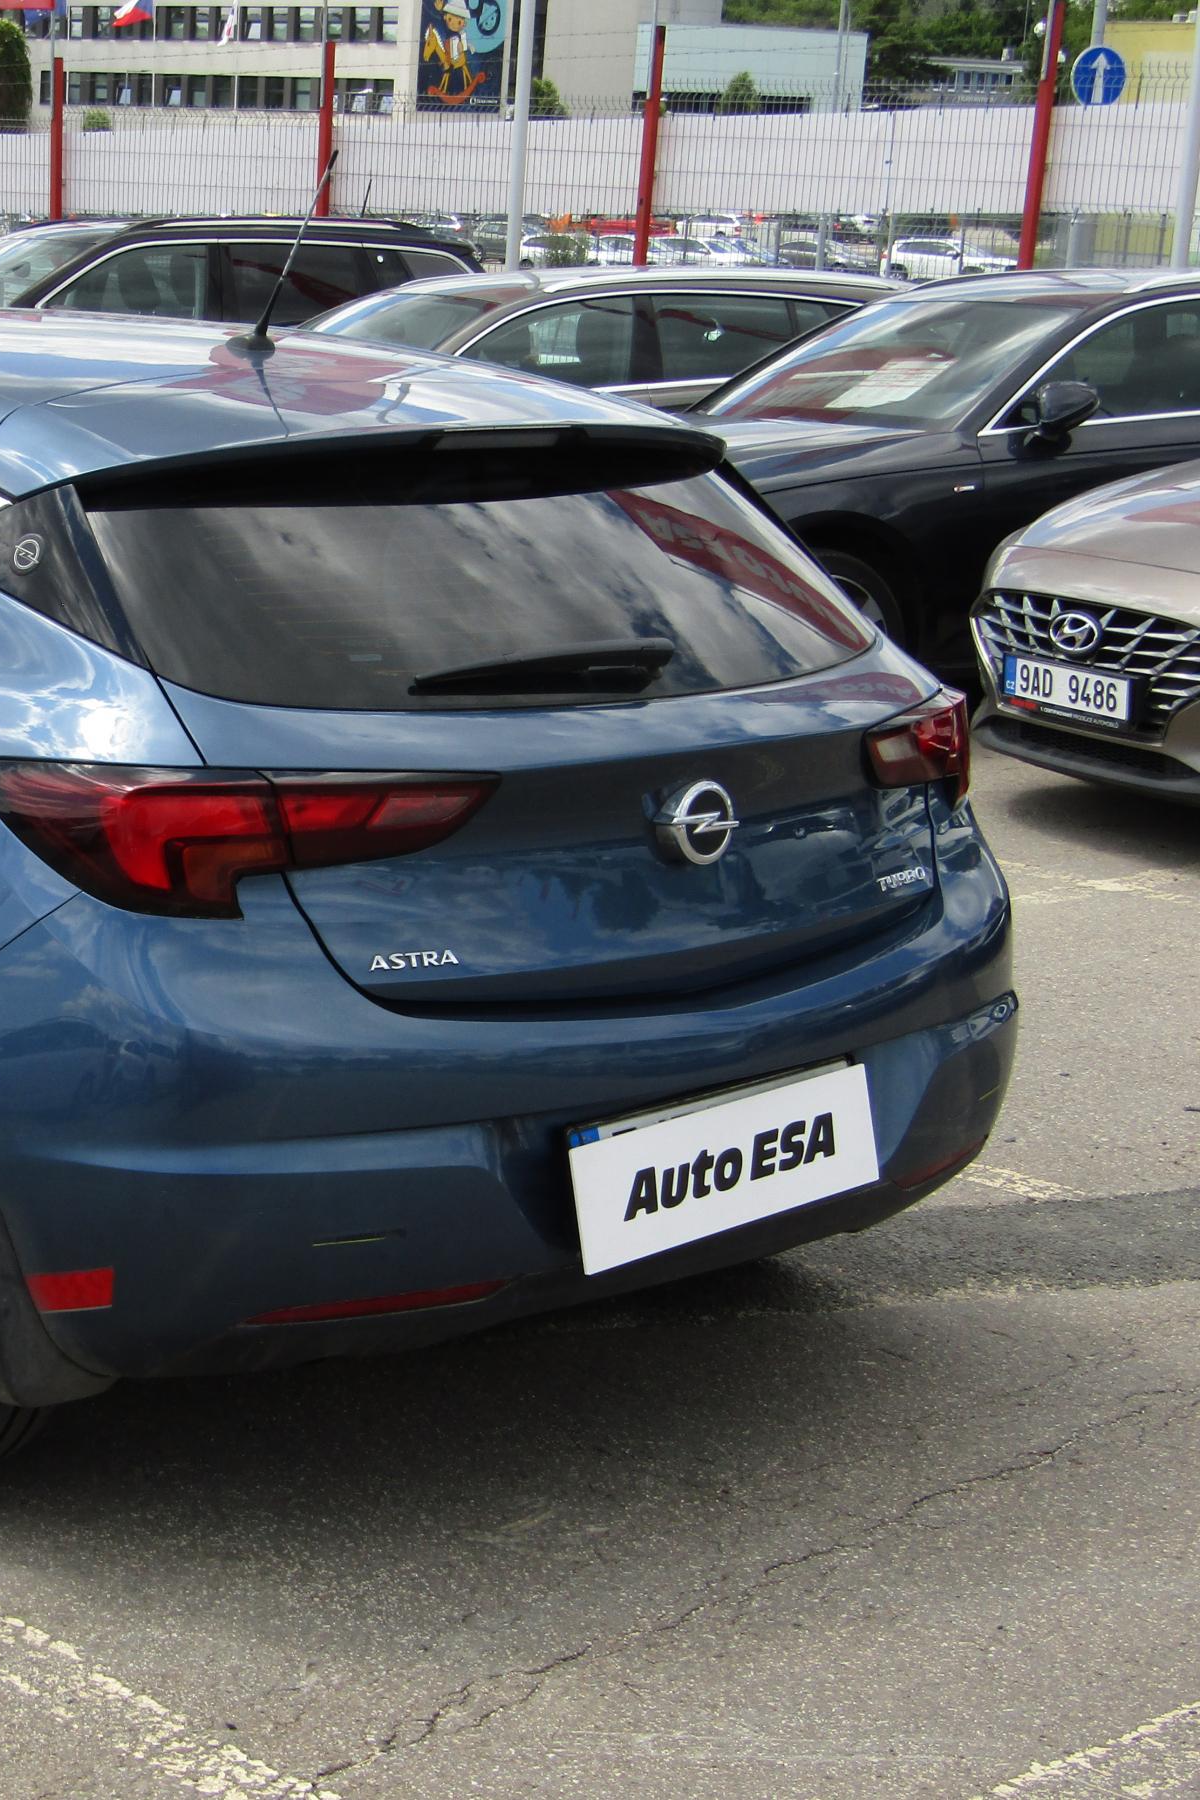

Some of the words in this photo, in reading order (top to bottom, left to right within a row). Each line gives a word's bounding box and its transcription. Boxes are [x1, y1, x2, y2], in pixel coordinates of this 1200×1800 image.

[1005, 680, 1015, 690] CZ
[1019, 663, 1054, 698] 9AD
[1068, 674, 1118, 712] 9486
[876, 866, 926, 892] TURBO
[369, 949, 460, 972] ASTRA
[622, 1147, 743, 1222] Auto
[749, 1111, 836, 1182] ESA
